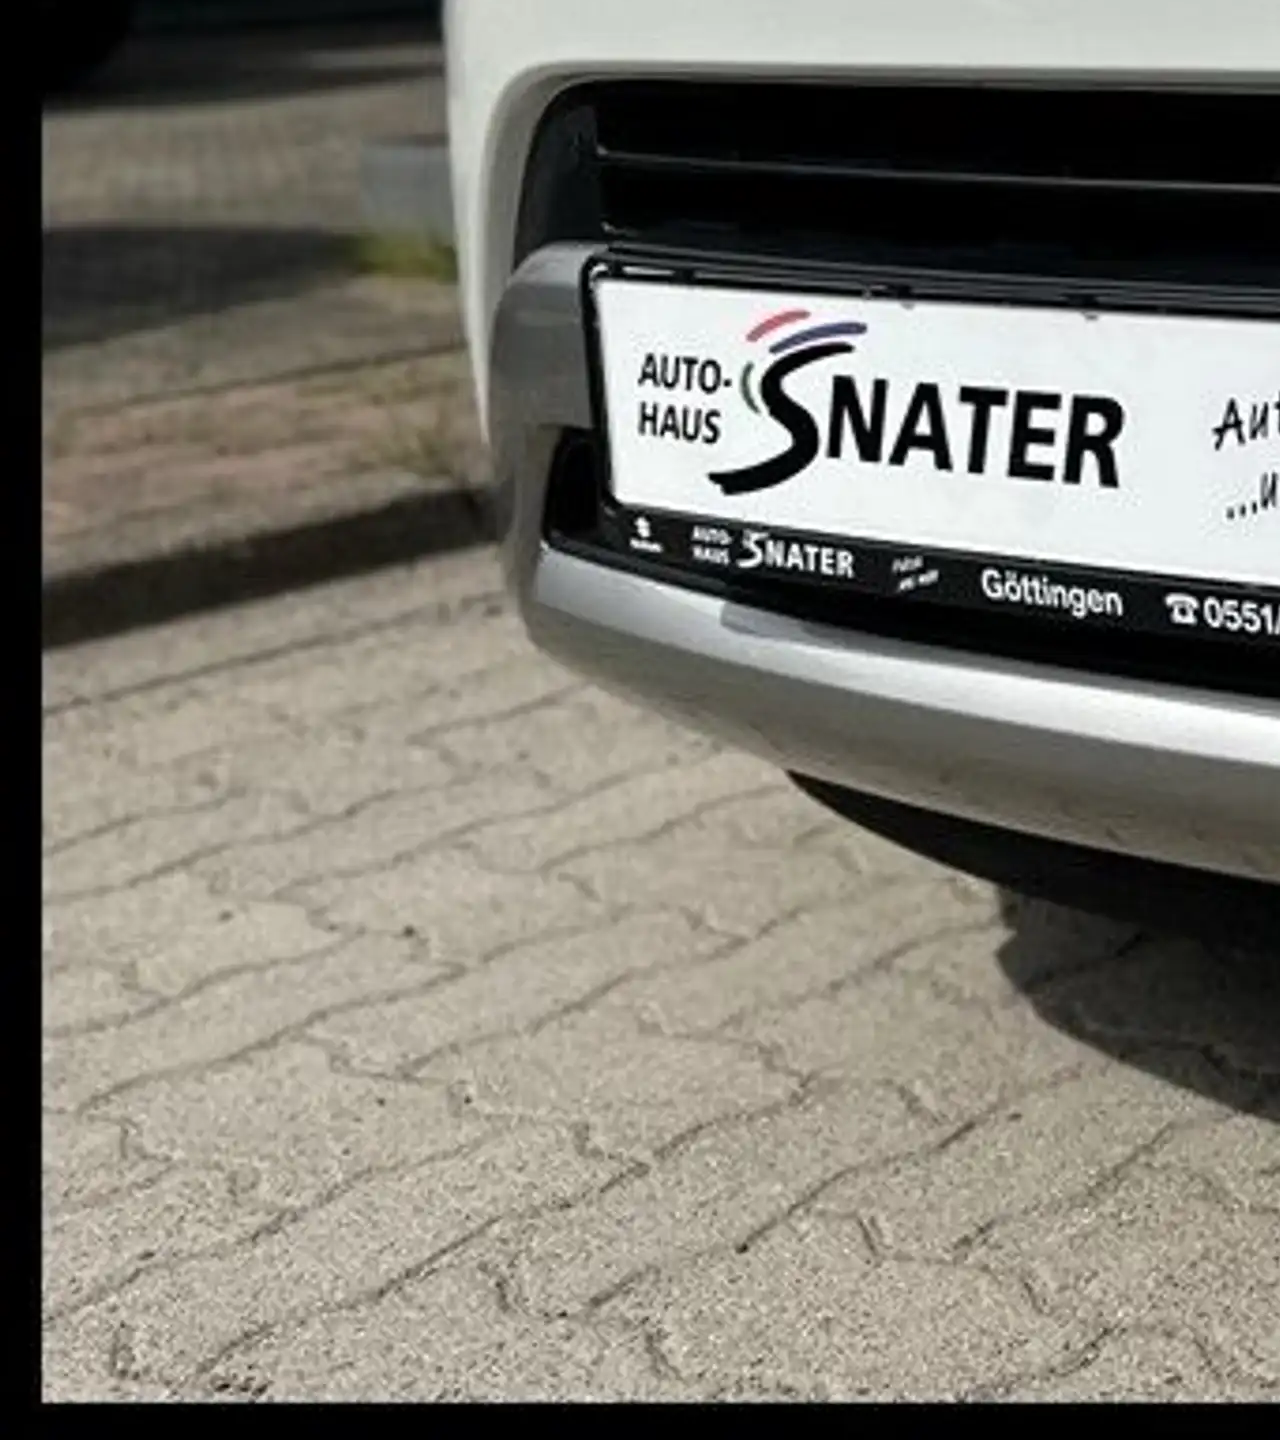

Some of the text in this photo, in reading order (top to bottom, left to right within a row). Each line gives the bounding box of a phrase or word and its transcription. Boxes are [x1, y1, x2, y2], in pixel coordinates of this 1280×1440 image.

[638, 353, 732, 394] AUTO-
[637, 400, 722, 444] HAUS
[708, 341, 1126, 495] SNATER
[738, 528, 855, 578] SNATER
[980, 568, 1124, 618] Göttingen
